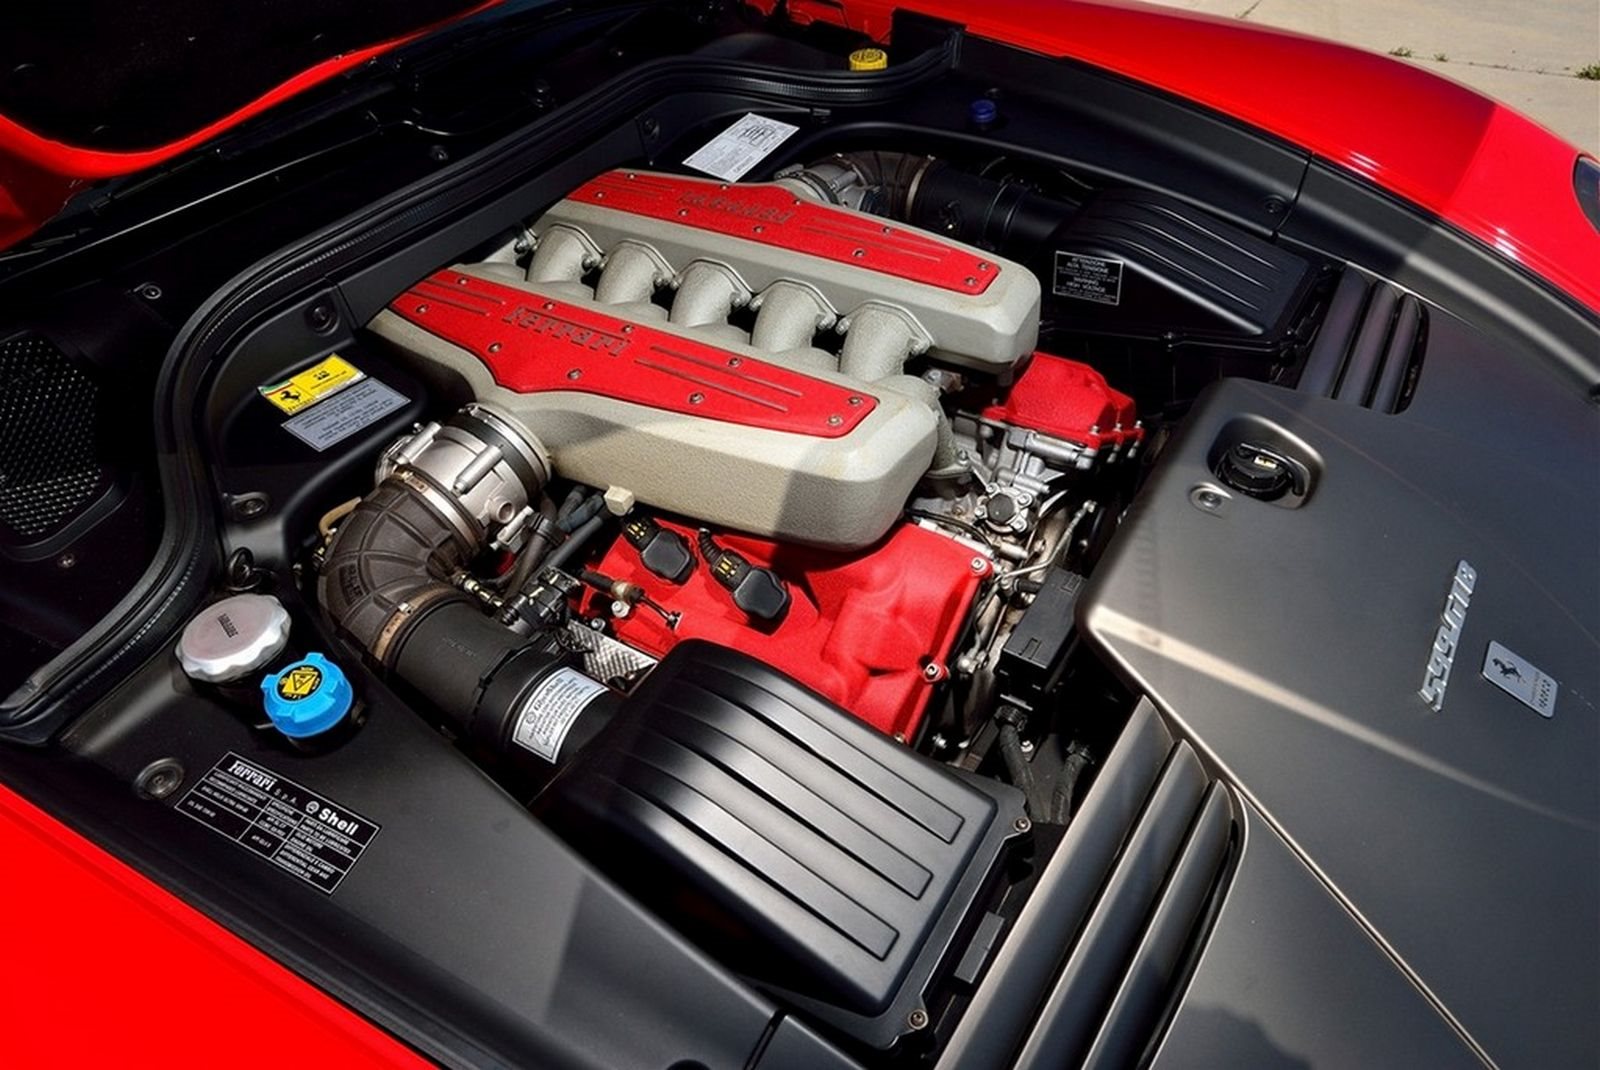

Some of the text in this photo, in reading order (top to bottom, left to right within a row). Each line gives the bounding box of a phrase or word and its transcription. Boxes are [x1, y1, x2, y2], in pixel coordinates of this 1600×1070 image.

[502, 306, 631, 357] Ferrari
[227, 760, 278, 792] Ferrari
[318, 808, 360, 836] Shell
